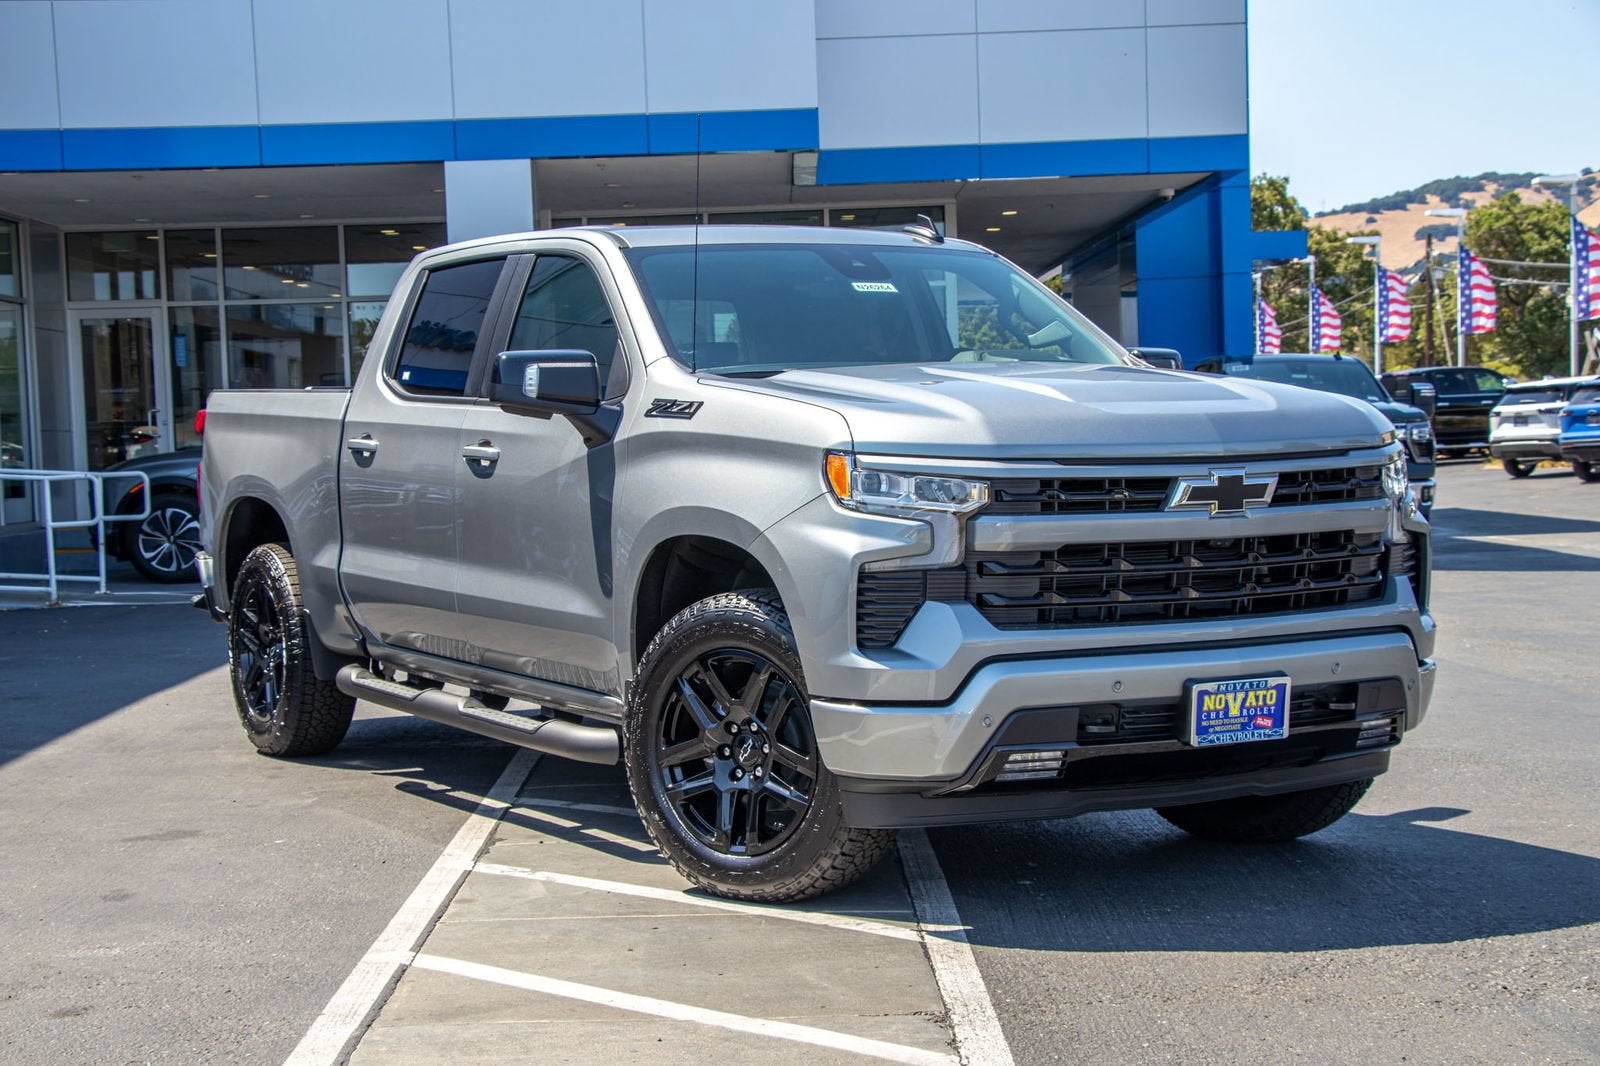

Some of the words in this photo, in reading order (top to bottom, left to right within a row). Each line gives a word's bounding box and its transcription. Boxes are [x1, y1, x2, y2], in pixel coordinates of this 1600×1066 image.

[644, 398, 704, 420] Z71
[1219, 681, 1266, 692] NOVATO
[1202, 689, 1277, 717] NOVATO
[1214, 730, 1266, 743] CHEVROLET
